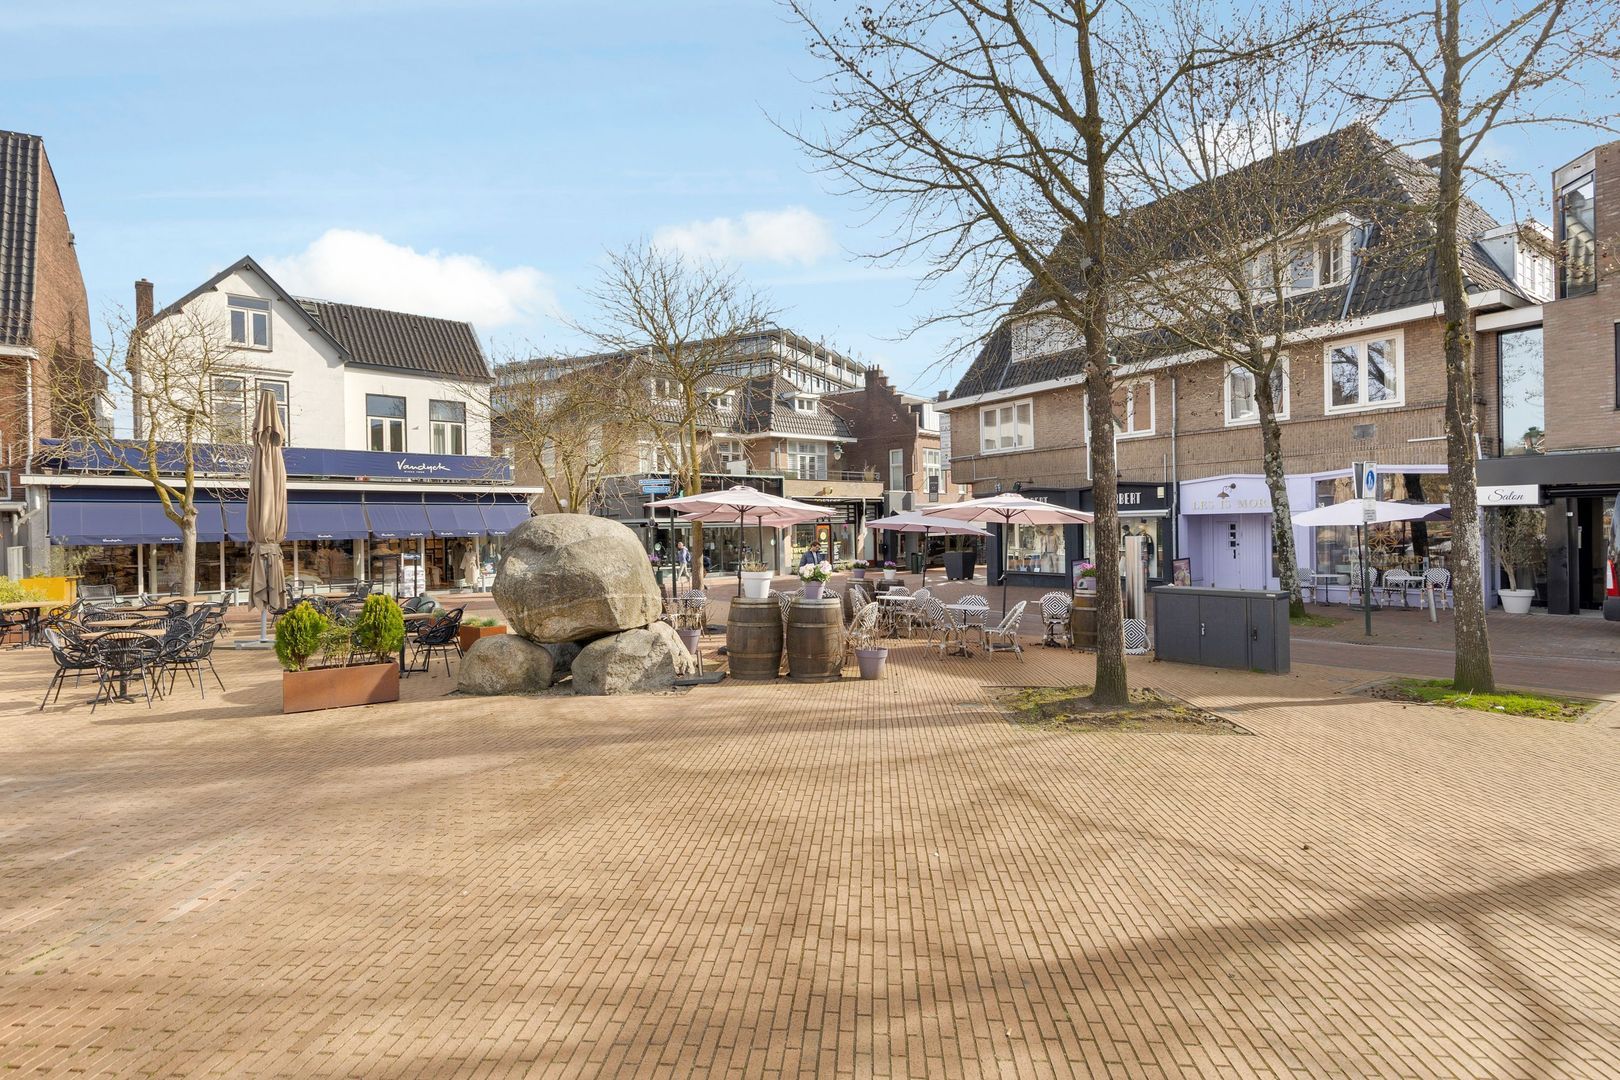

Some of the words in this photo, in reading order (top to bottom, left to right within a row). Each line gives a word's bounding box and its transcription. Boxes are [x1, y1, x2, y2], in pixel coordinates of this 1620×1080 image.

[396, 458, 451, 473] Vandyck
[1488, 489, 1524, 502] Salon
[1220, 500, 1232, 509] IS
[1237, 499, 1268, 509] MOR
